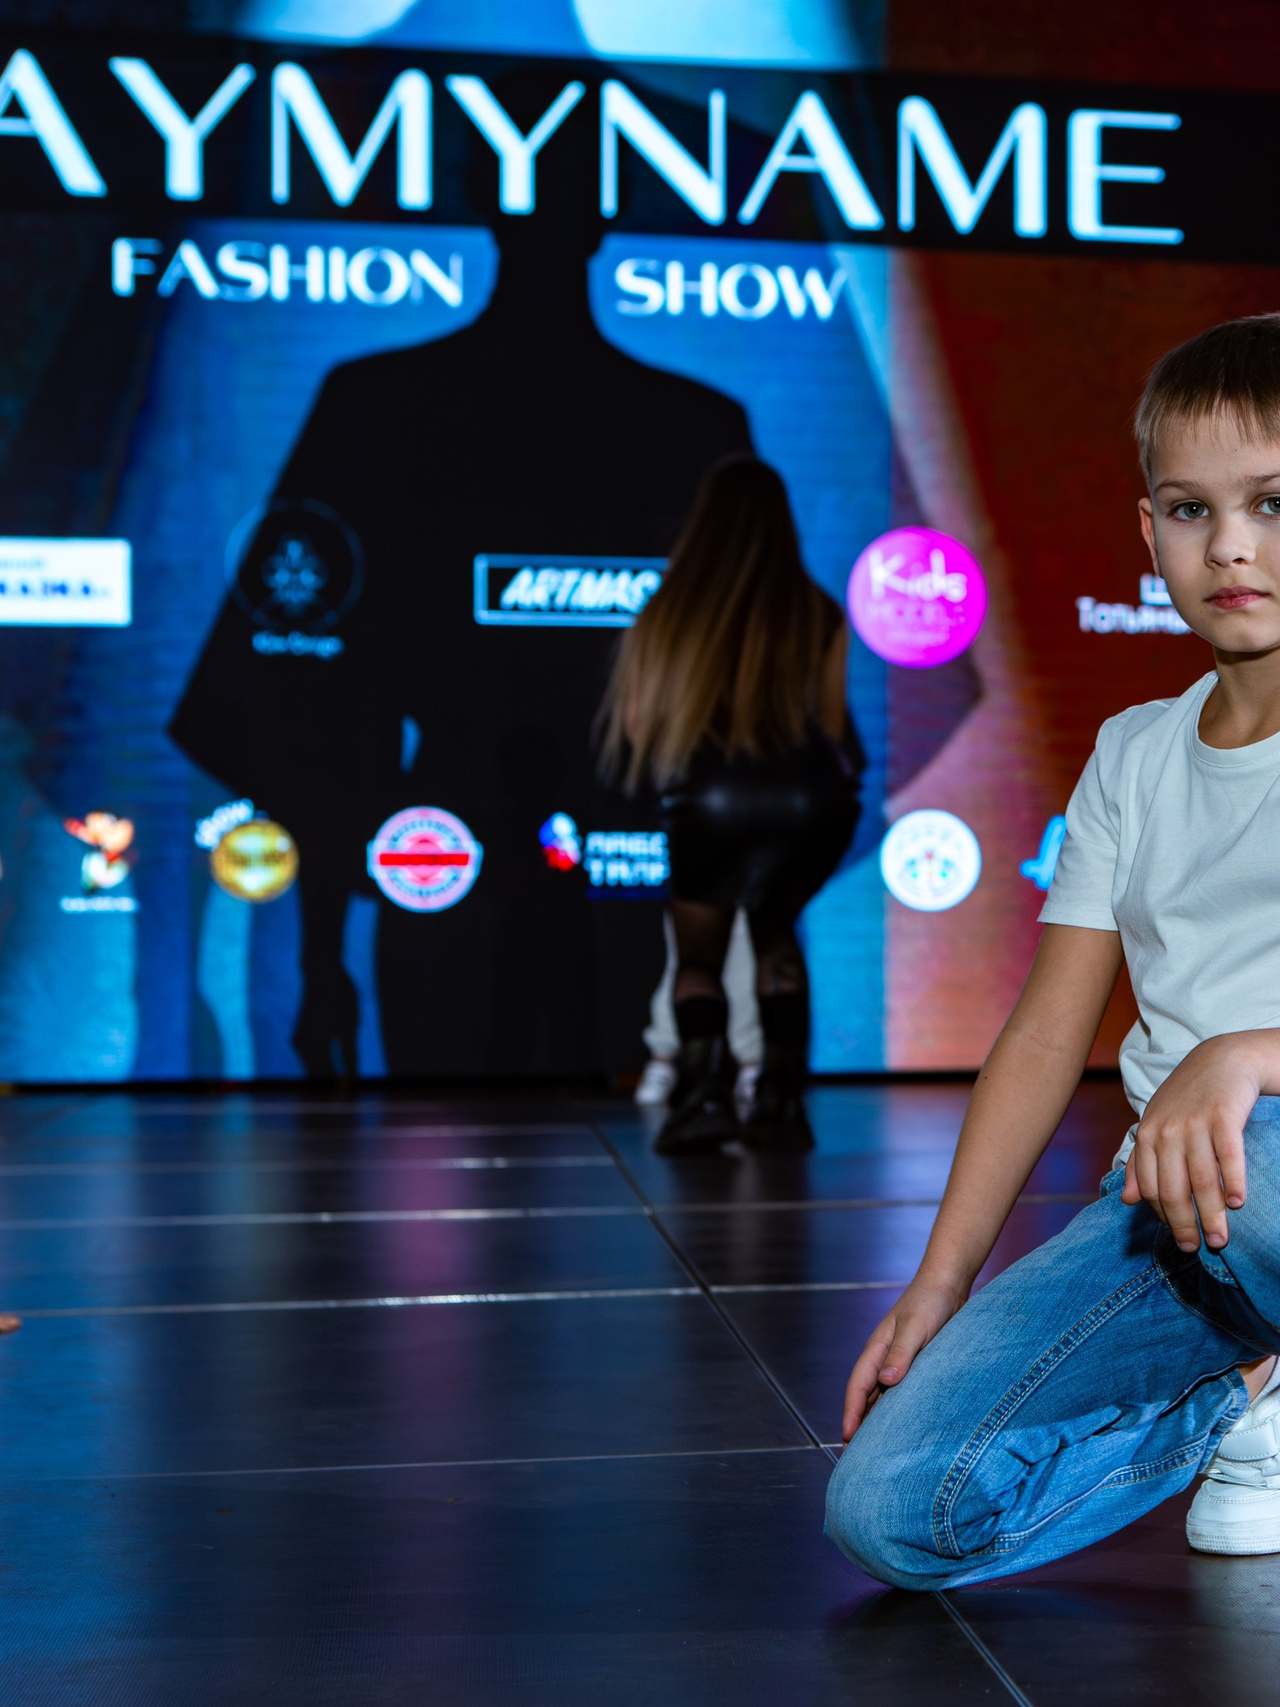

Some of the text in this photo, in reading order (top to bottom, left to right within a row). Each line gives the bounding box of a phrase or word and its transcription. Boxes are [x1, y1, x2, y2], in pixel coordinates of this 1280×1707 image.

[111, 236, 848, 321] FASHION SHOW
[868, 547, 968, 604] Kids
